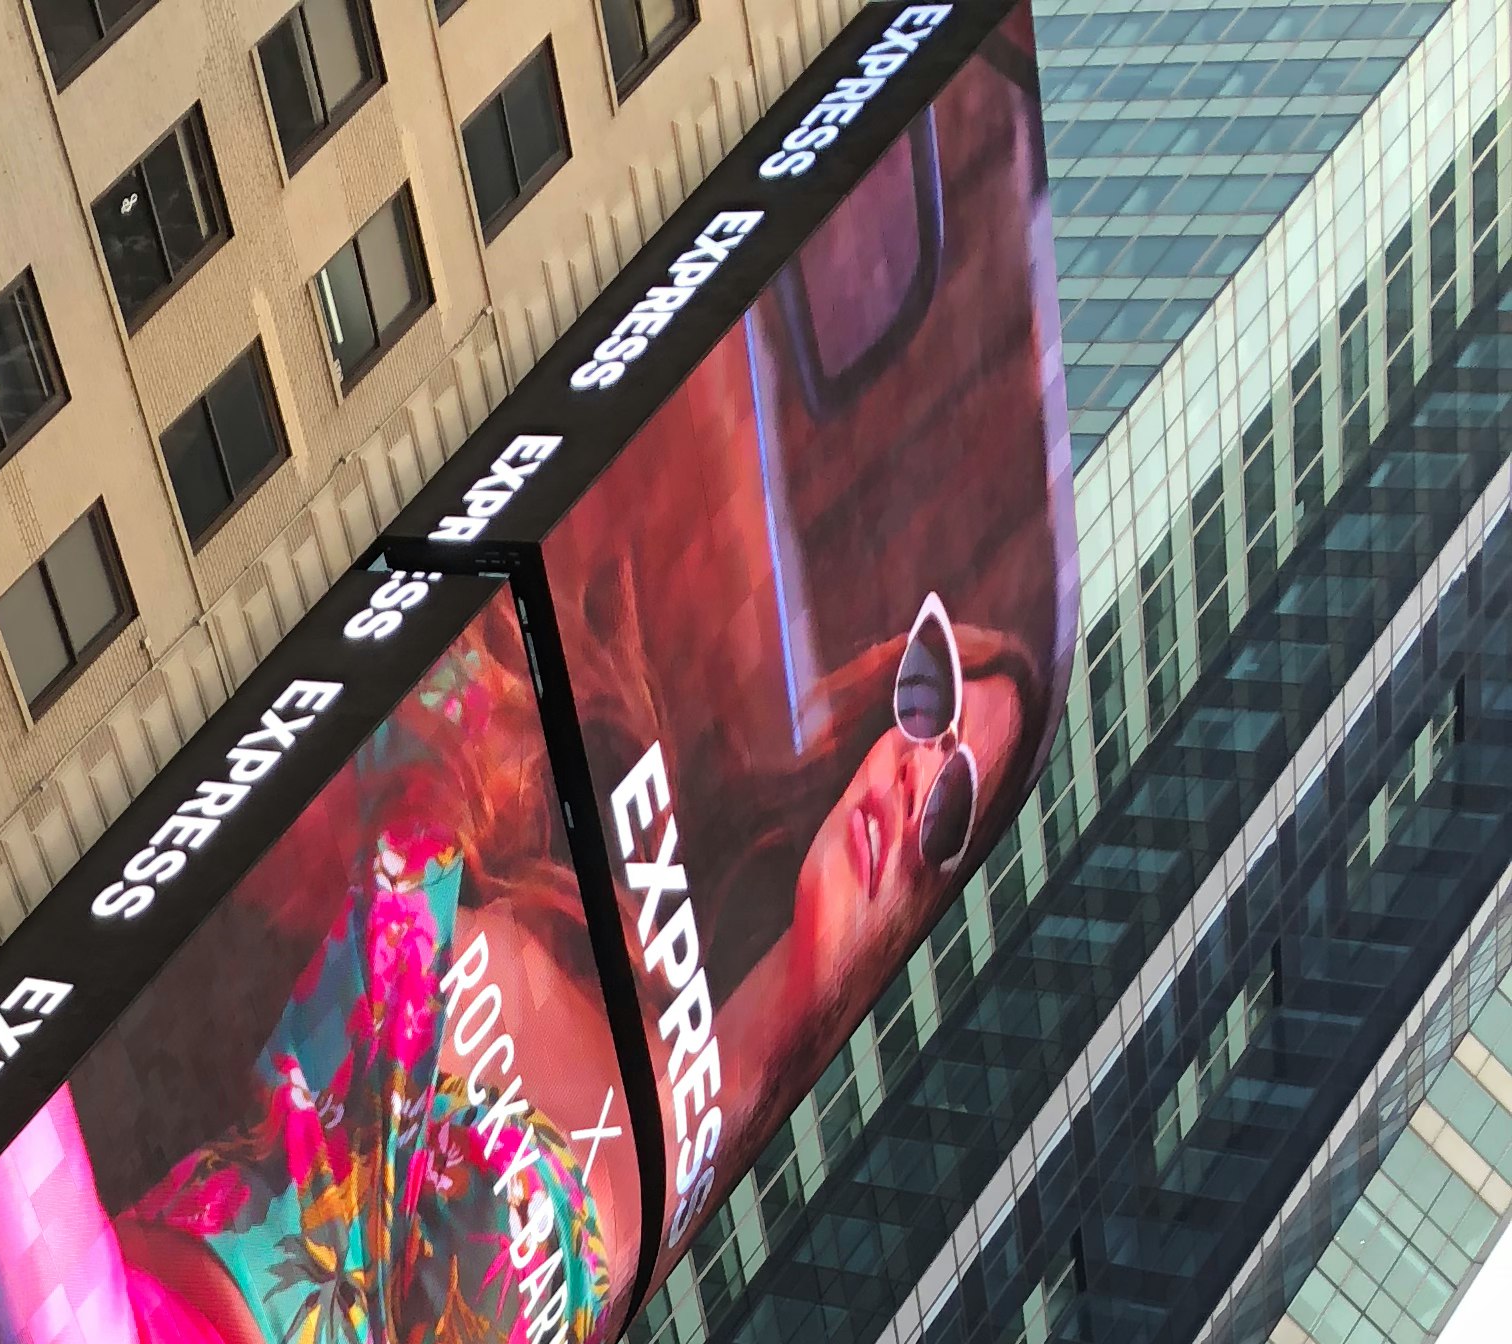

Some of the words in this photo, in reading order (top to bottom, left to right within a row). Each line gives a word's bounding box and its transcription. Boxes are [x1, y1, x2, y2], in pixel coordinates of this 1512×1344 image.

[760, 2, 953, 179] EXPRESS
[571, 210, 765, 391] EXPRESS
[91, 678, 344, 921] EXPRESS
[440, 931, 542, 1198] ROCKY
[610, 739, 725, 1249] EXPRESS
[570, 1085, 623, 1186] X
